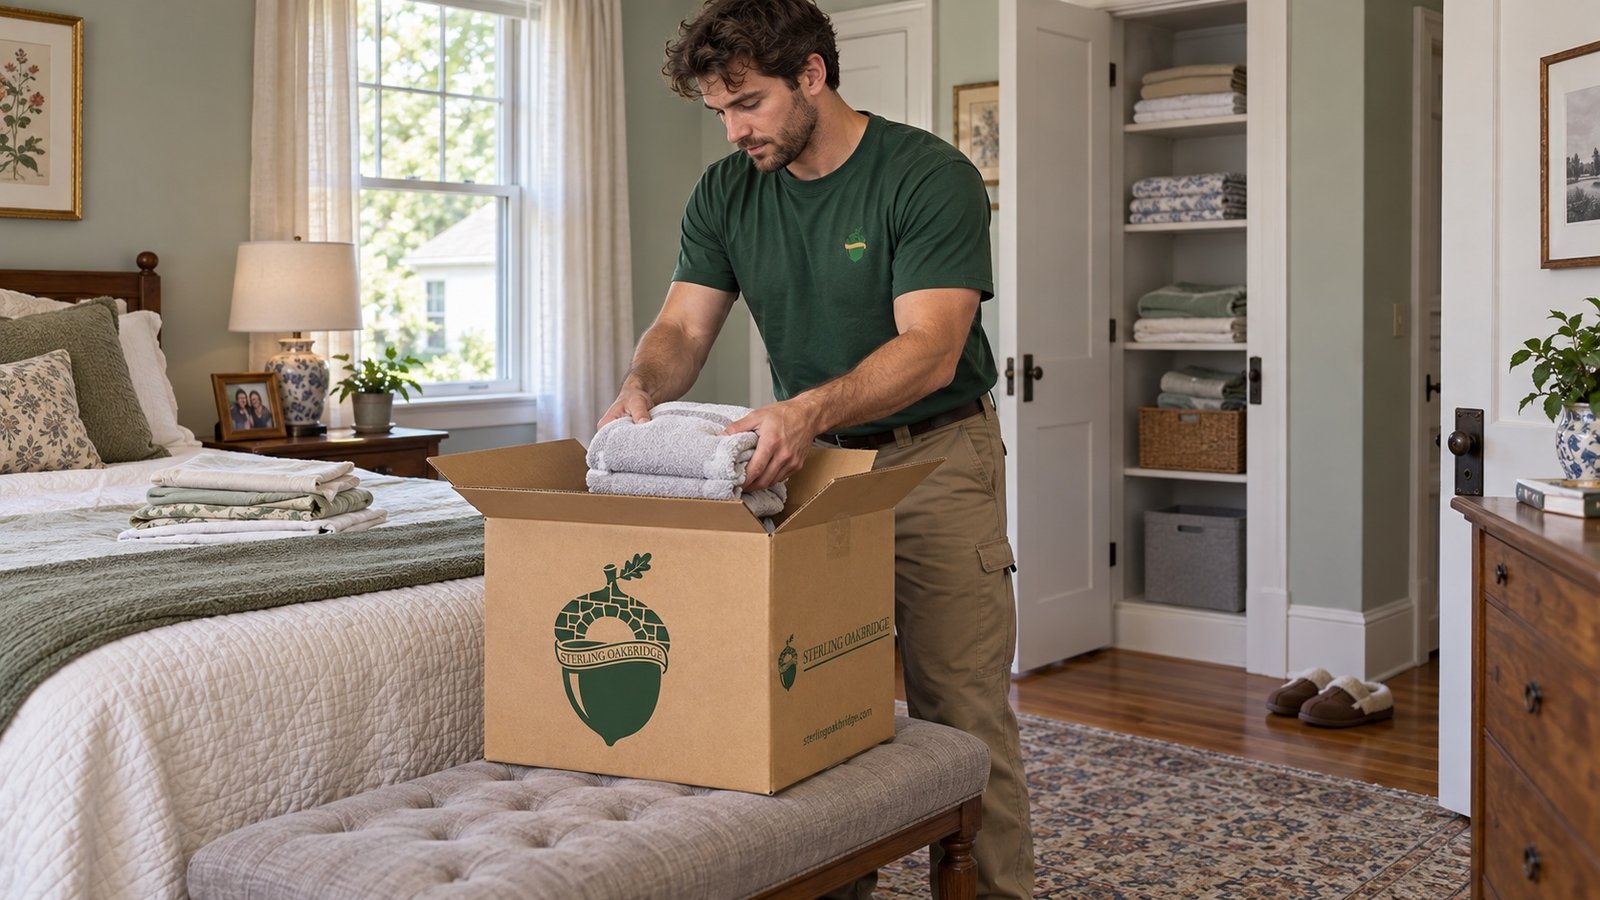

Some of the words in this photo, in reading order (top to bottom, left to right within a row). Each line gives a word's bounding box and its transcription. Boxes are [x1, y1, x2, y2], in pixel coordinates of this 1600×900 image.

[561, 650, 606, 665] STERLING
[607, 645, 663, 660] OAKBRIDGE
[803, 636, 843, 664] STERLING
[844, 617, 890, 646] OAKBRIDGE
[803, 707, 873, 746] sterlingoakbridge.com
